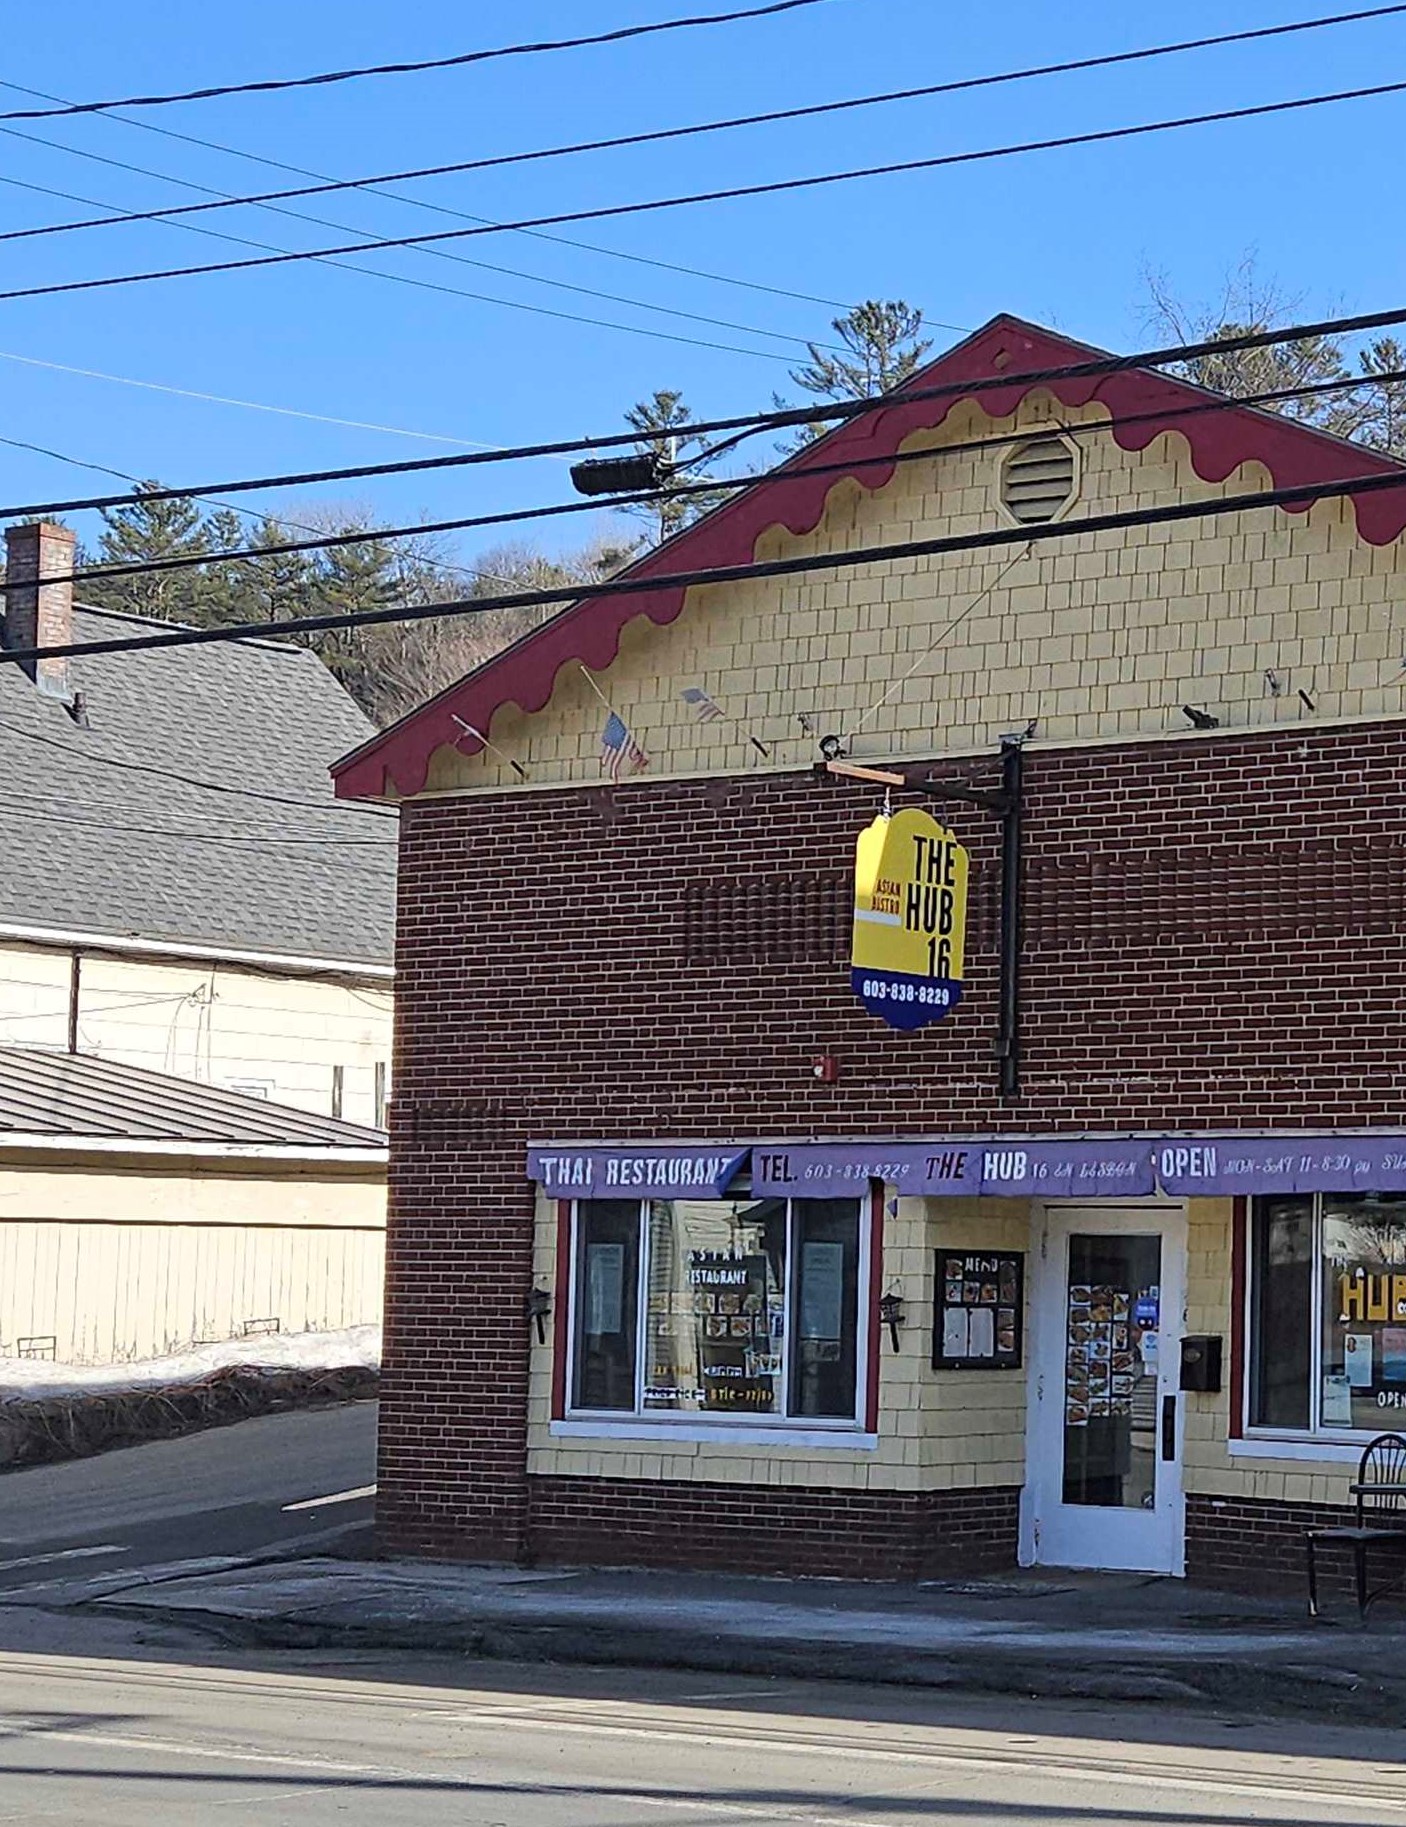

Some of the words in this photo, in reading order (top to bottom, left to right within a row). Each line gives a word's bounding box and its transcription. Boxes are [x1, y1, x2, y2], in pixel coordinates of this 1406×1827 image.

[913, 835, 957, 886] THE
[876, 879, 901, 897] ASIAN
[906, 883, 953, 935] HUB
[928, 936, 951, 979] 16
[539, 1157, 593, 1185] THAI
[760, 1154, 799, 1183] TEL.
[926, 1151, 968, 1180] THE
[984, 1151, 1028, 1181] HUB
[1033, 1163, 1047, 1179] 16
[1161, 1147, 1217, 1178] OPEN
